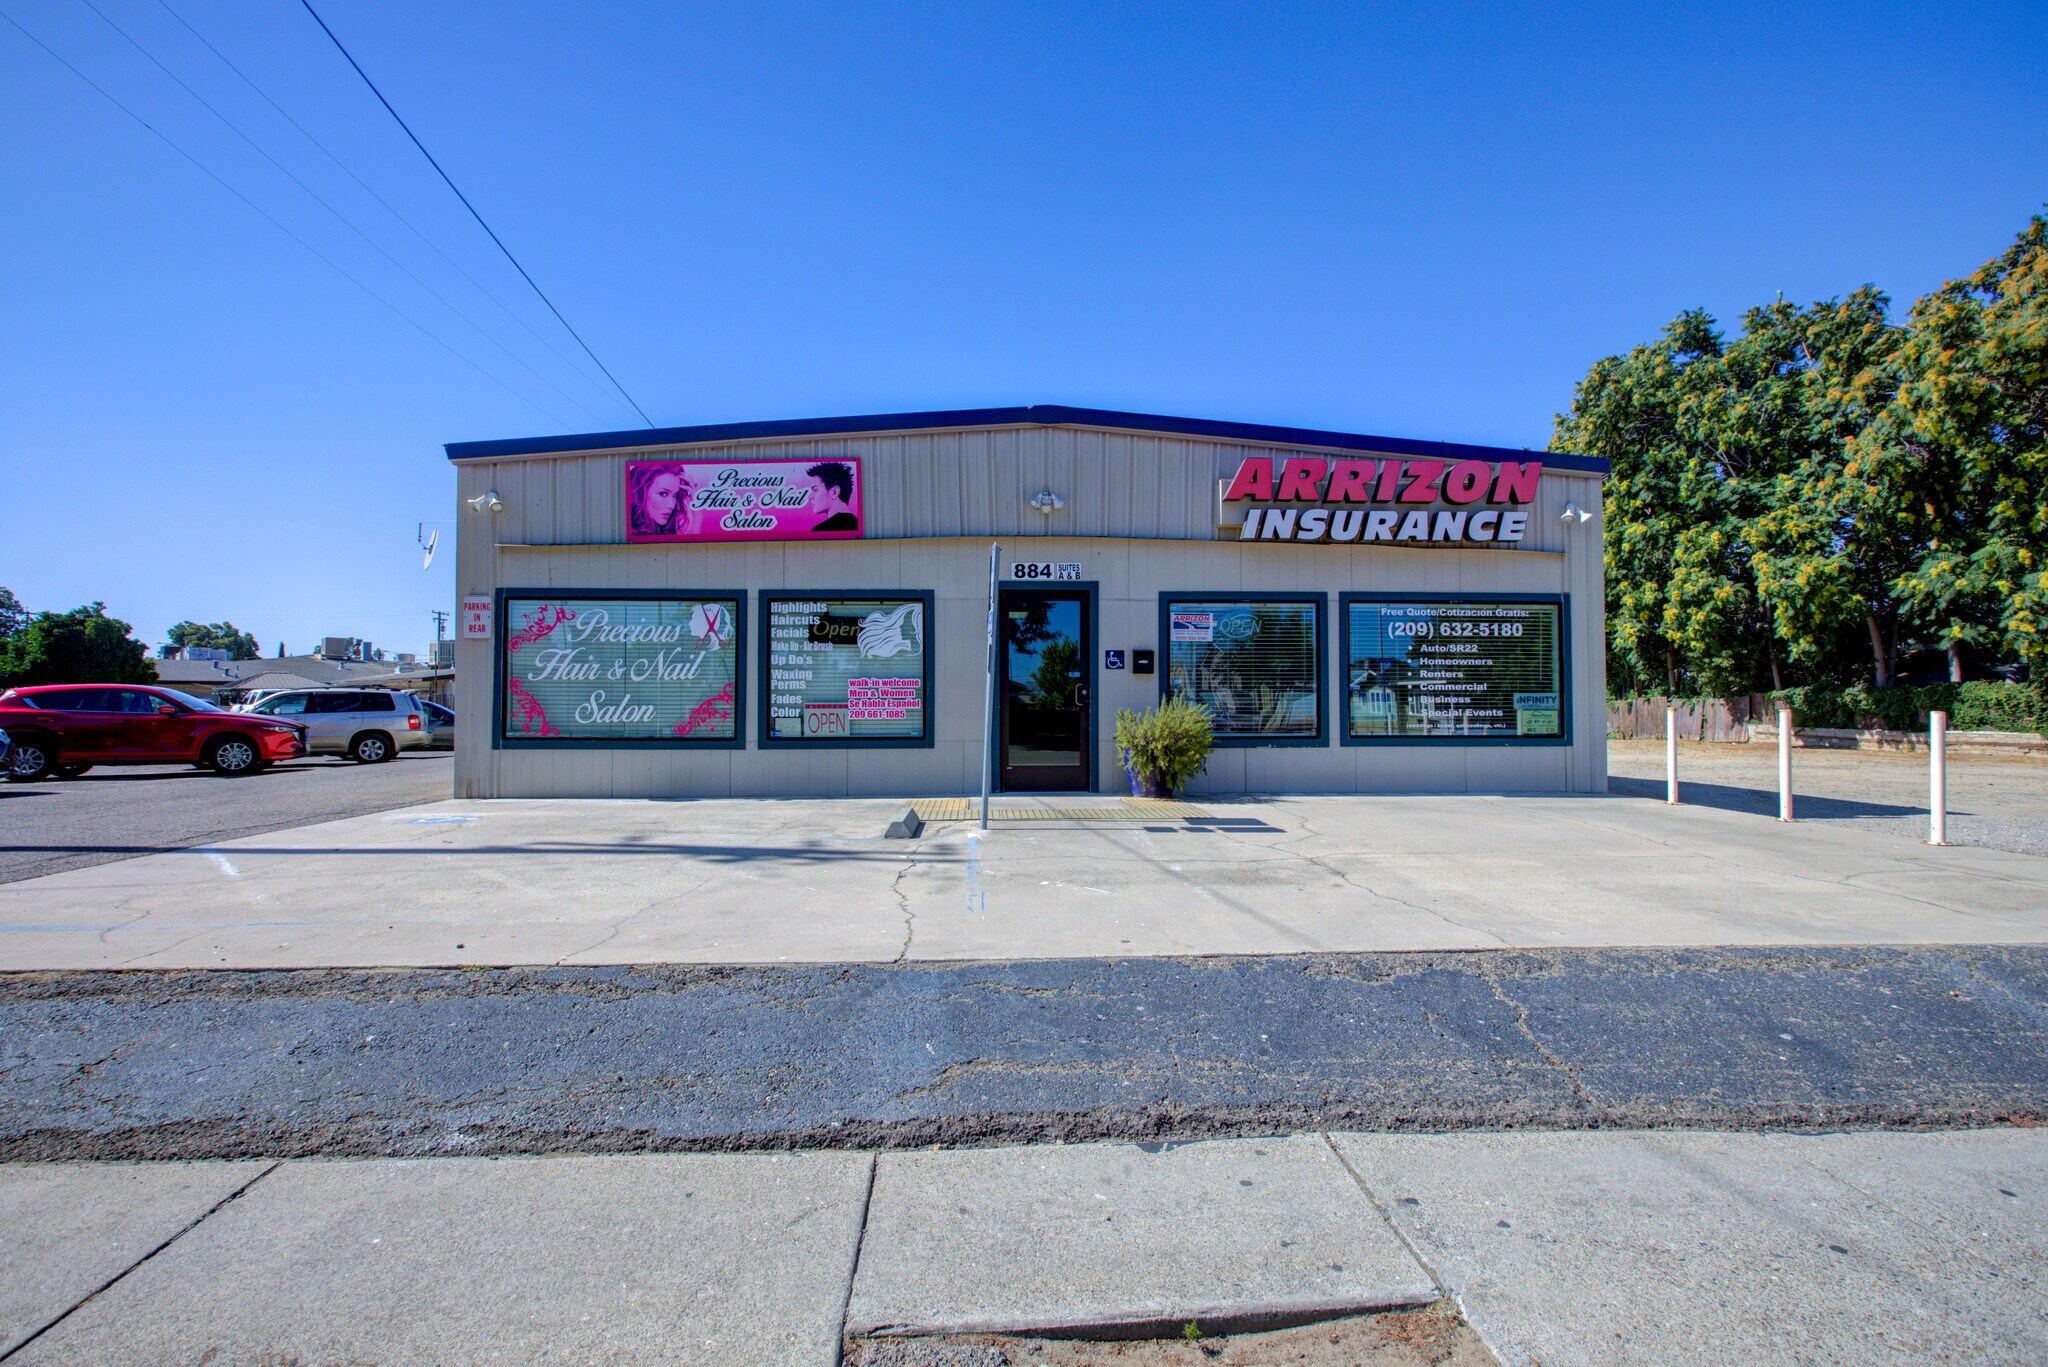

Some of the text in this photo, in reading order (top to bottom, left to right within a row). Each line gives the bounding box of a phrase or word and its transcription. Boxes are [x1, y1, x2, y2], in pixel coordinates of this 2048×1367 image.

[712, 468, 784, 488] Precious
[1223, 457, 1543, 503] ARRIZON
[692, 487, 809, 509] Hair & Nail
[722, 509, 775, 529] Salon
[1240, 508, 1529, 541] INSURANCE
[1014, 564, 1052, 578] 884
[770, 602, 828, 613] Highlights
[1381, 608, 1404, 616] Free
[1495, 608, 1530, 617] Gratis:
[567, 608, 682, 643] Precious
[770, 615, 820, 625] Haircuts
[469, 624, 486, 632] REAR
[813, 621, 861, 639] Open
[1220, 619, 1262, 633] OPEN
[1388, 621, 1524, 639] (209) 632-5180
[770, 628, 809, 638] Facials
[771, 641, 789, 651] Make
[790, 641, 799, 652] Up
[803, 641, 812, 651] Air
[813, 641, 833, 651] Brush
[1420, 643, 1479, 653] Auto/SR22
[527, 647, 706, 681] Hair & Nail
[771, 655, 813, 666] Up Do's
[1420, 657, 1493, 666] Homeowners
[771, 669, 813, 680] Waxing
[1420, 670, 1464, 678] Renters
[771, 680, 806, 689] Perms
[849, 678, 920, 687] walk-in welcome
[1420, 682, 1488, 691] Commercial
[771, 694, 802, 704] Fades
[849, 689, 915, 698] Men & Women
[1420, 695, 1471, 703] Business
[575, 690, 657, 724] Salon
[849, 699, 860, 708] Se
[861, 699, 886, 708] Habla
[887, 698, 920, 709] Español
[771, 707, 800, 717] Color
[849, 709, 906, 719] 209 661-1085
[1420, 708, 1504, 718] Special Events
[808, 713, 846, 734] OPEN
